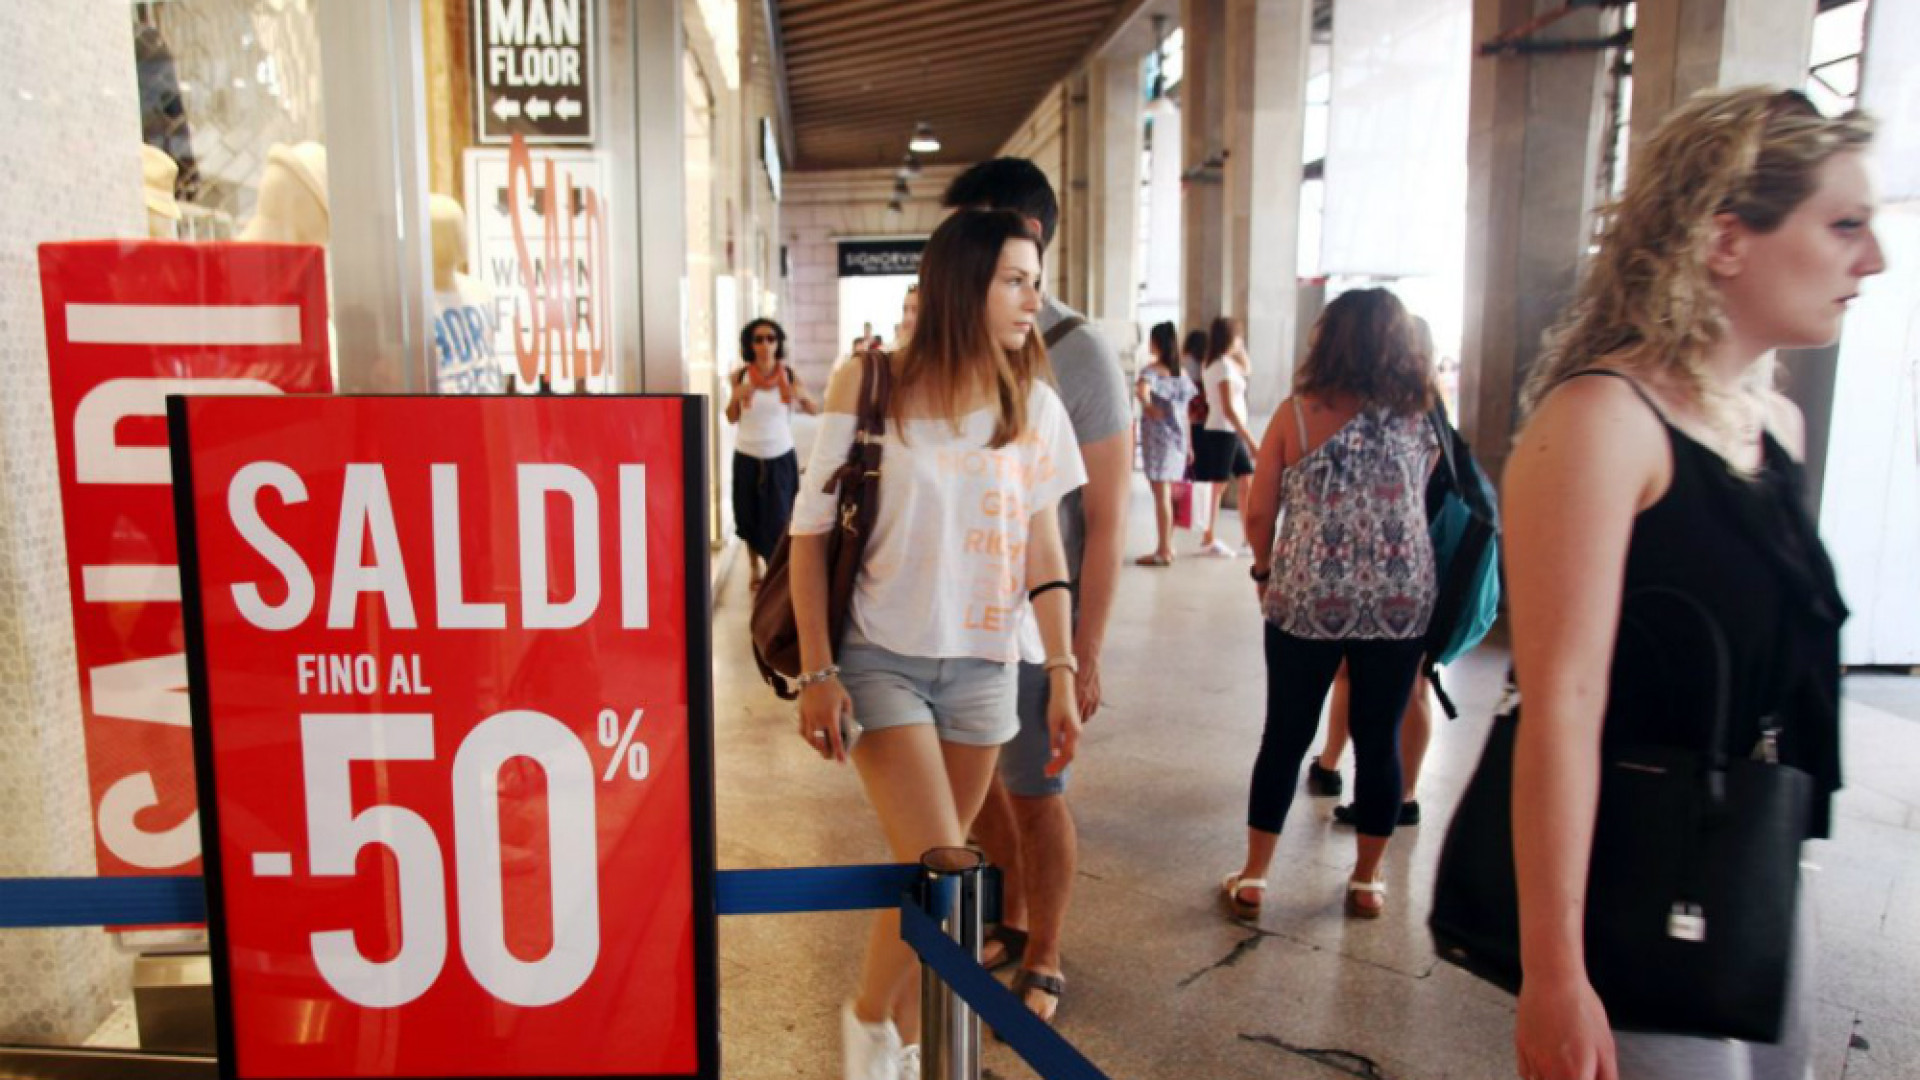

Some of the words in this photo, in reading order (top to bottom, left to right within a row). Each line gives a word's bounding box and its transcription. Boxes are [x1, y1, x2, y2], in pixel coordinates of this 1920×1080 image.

[489, 0, 580, 45] MAN
[488, 49, 580, 86] FLOOR
[227, 461, 649, 632] SALDI
[297, 654, 377, 694] FINO
[388, 654, 431, 694] AL
